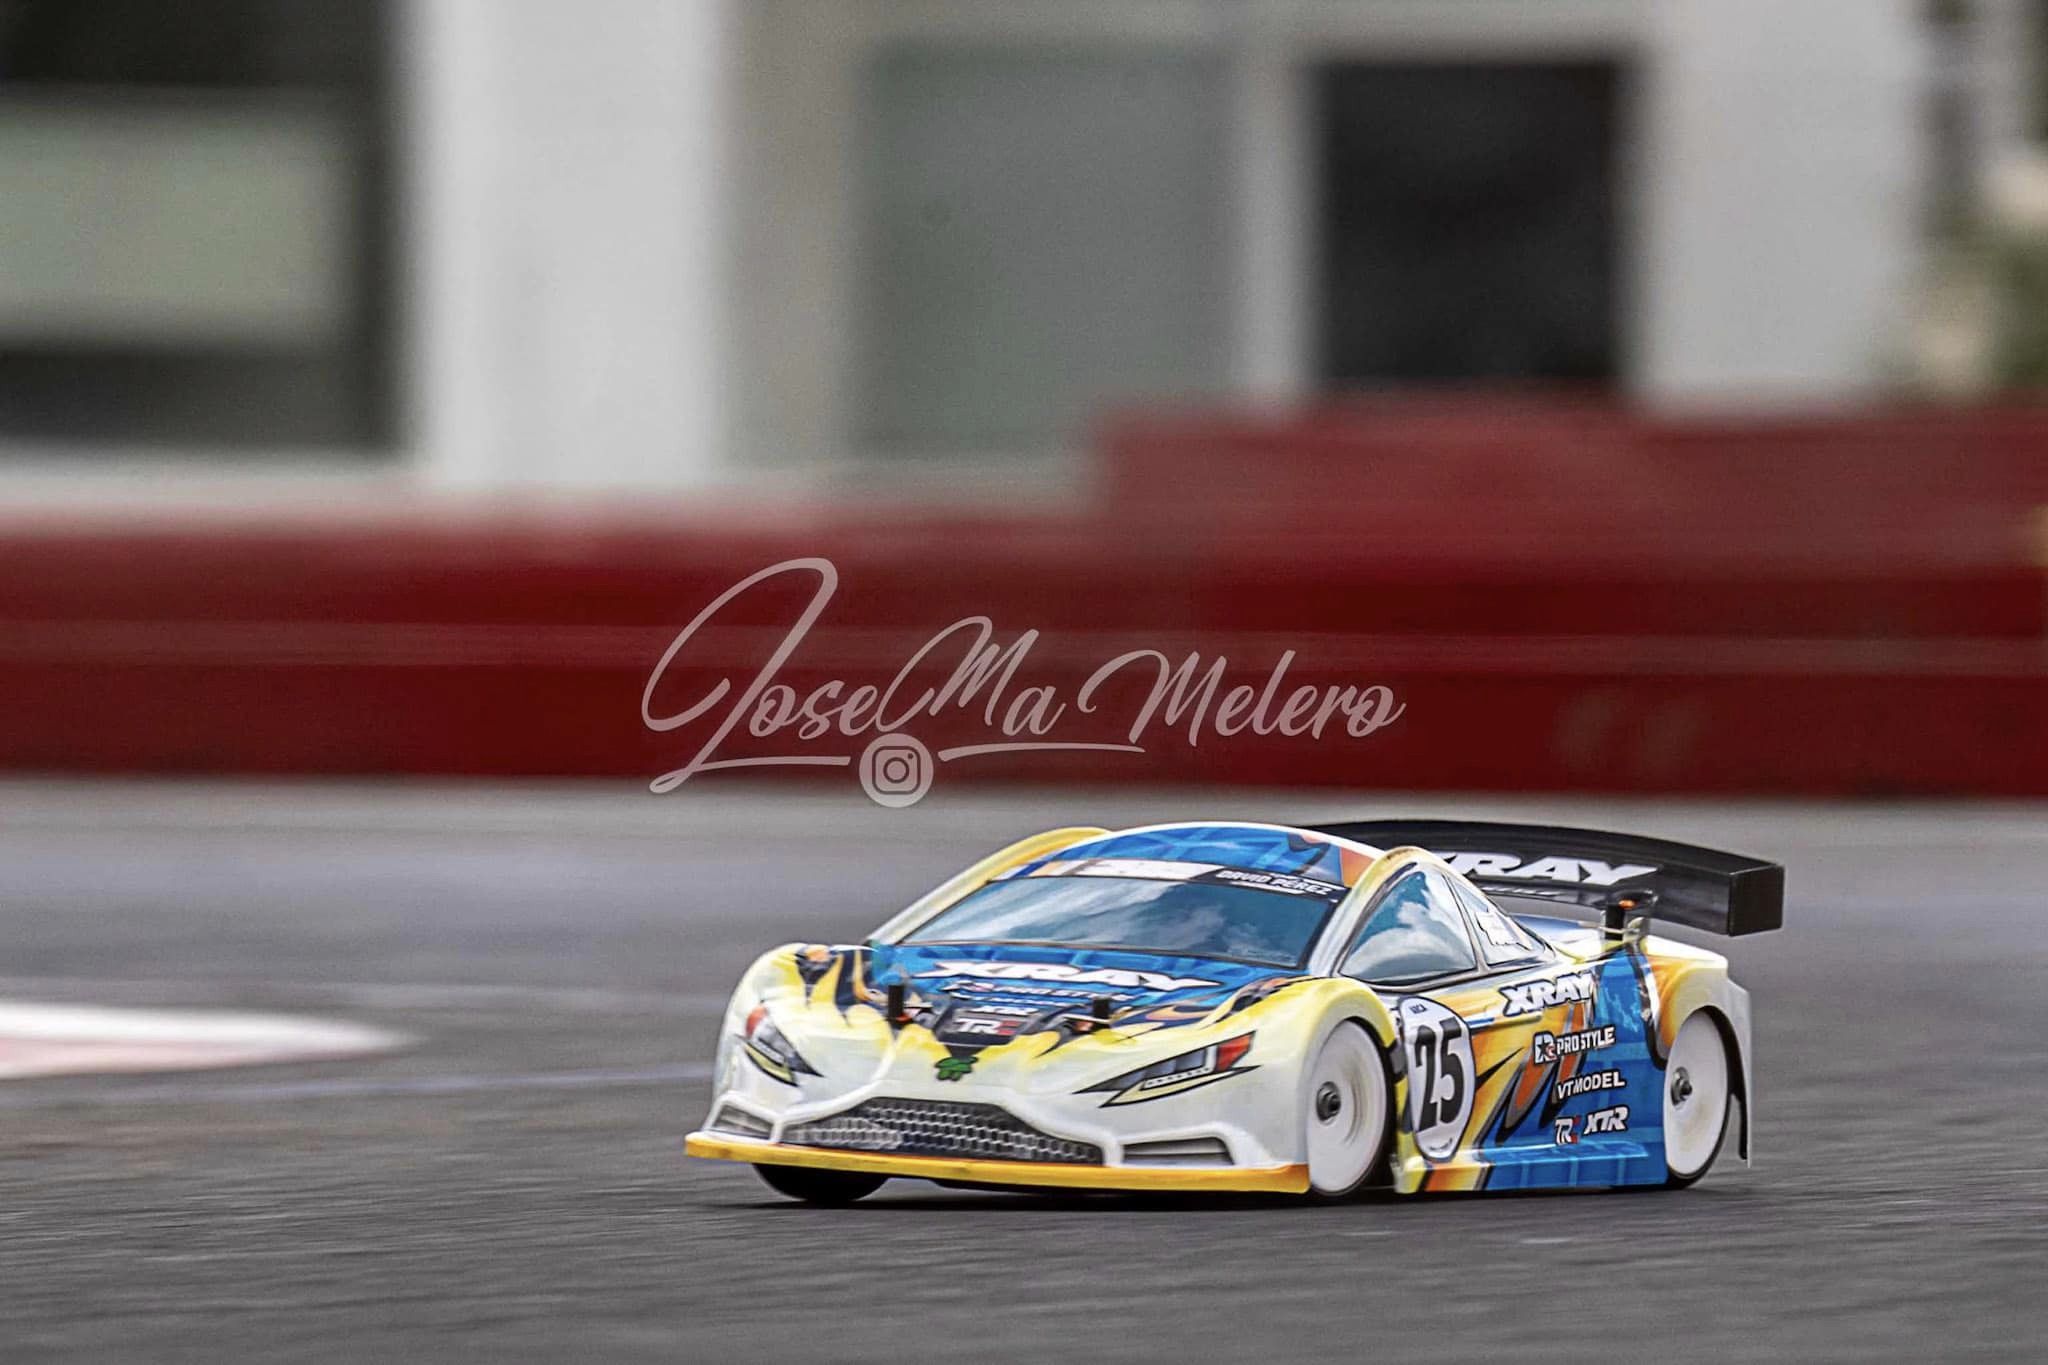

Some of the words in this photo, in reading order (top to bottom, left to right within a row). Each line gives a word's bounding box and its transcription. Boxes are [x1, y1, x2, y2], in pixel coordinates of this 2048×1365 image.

[913, 961, 1222, 991] XRAY
[1500, 972, 1594, 1016] XRAY
[1414, 1016, 1465, 1133] 25
[1583, 1107, 1628, 1135] XTR
